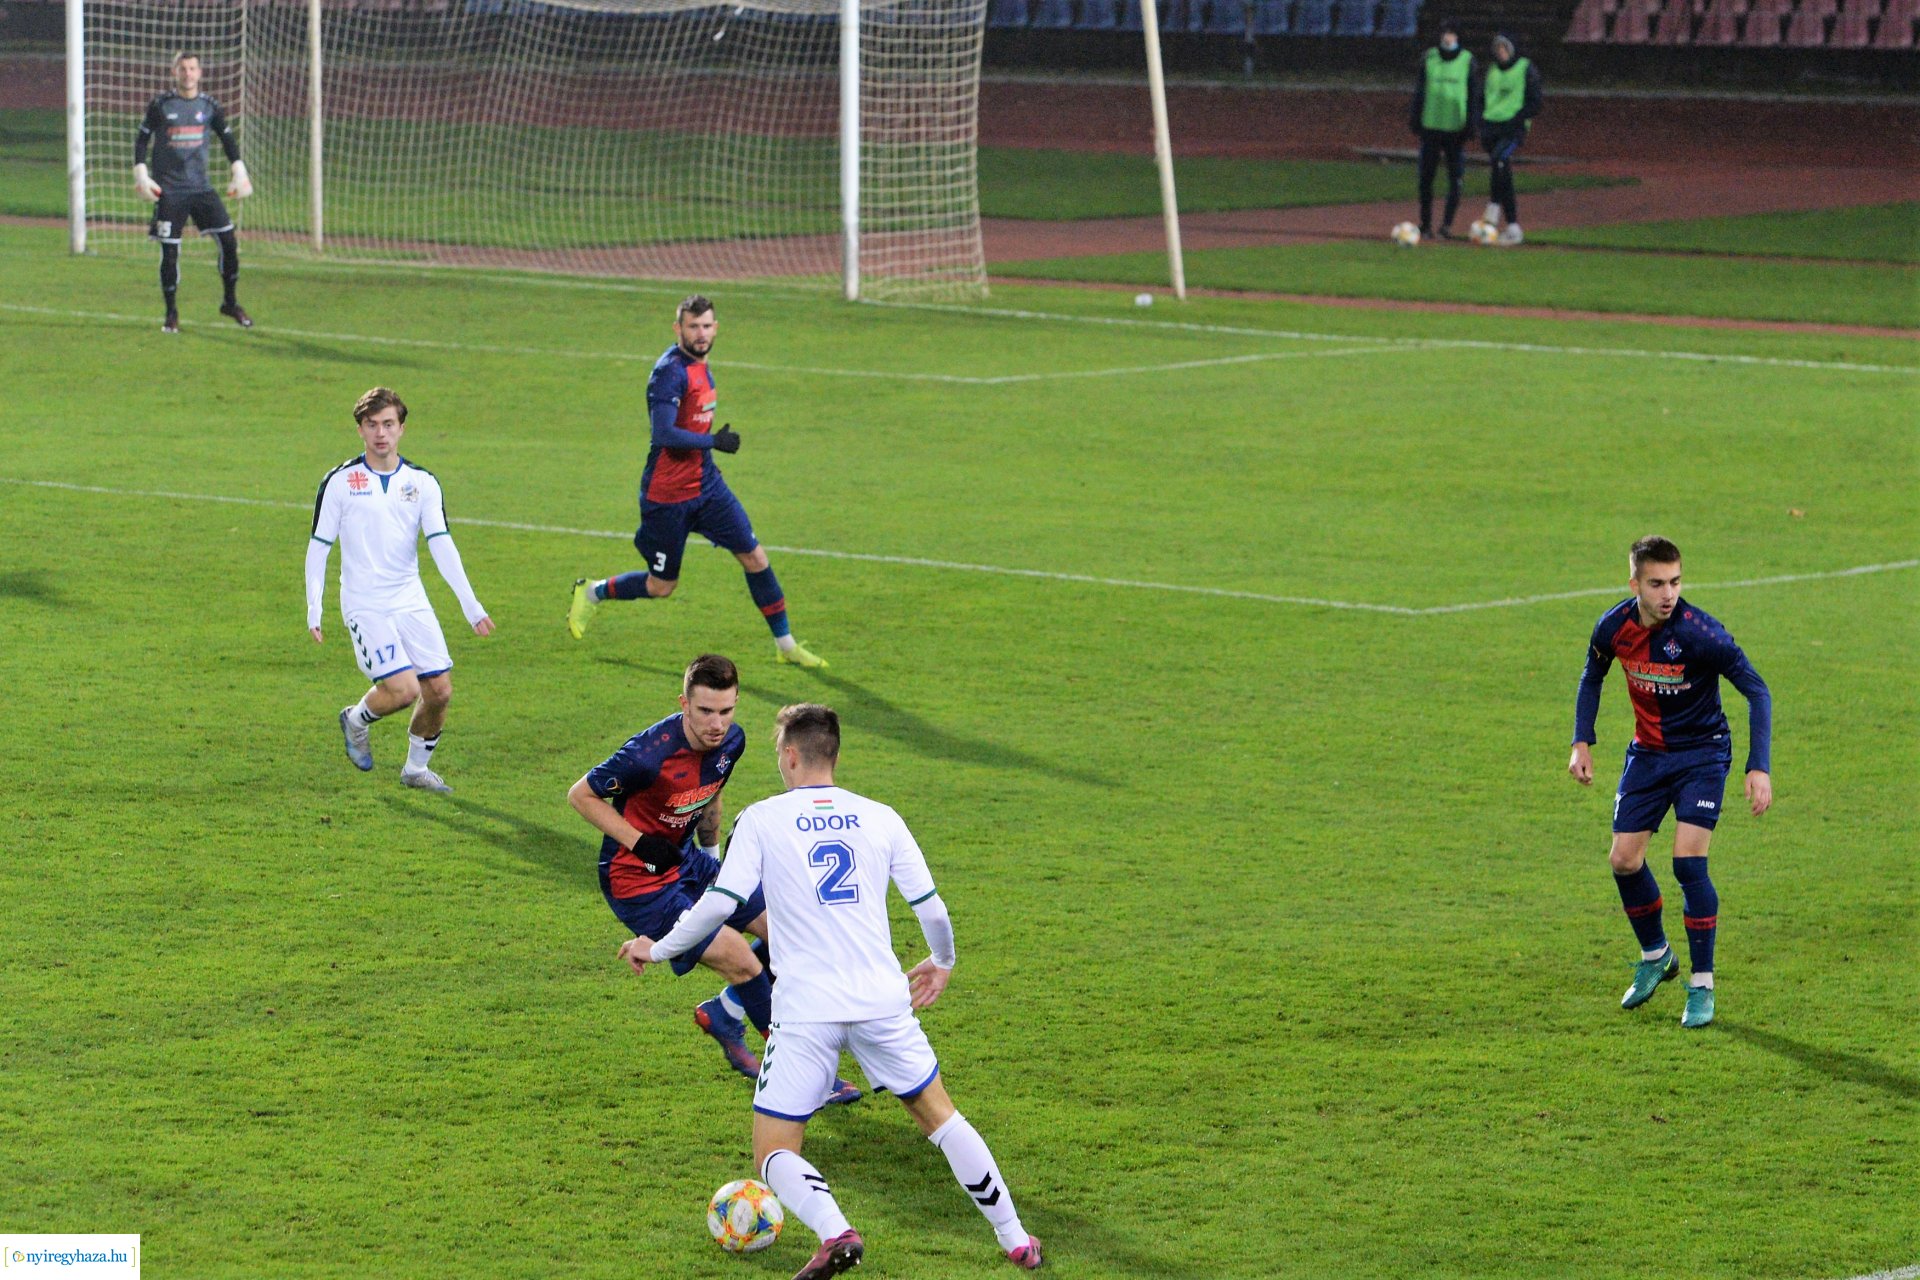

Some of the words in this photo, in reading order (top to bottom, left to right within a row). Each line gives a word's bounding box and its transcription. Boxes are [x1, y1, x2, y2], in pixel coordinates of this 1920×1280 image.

[653, 552, 666, 572] 3
[375, 644, 395, 664] 17
[1697, 800, 1715, 809] JAKO
[796, 813, 860, 832] ÓDOR
[807, 840, 859, 905] 2
